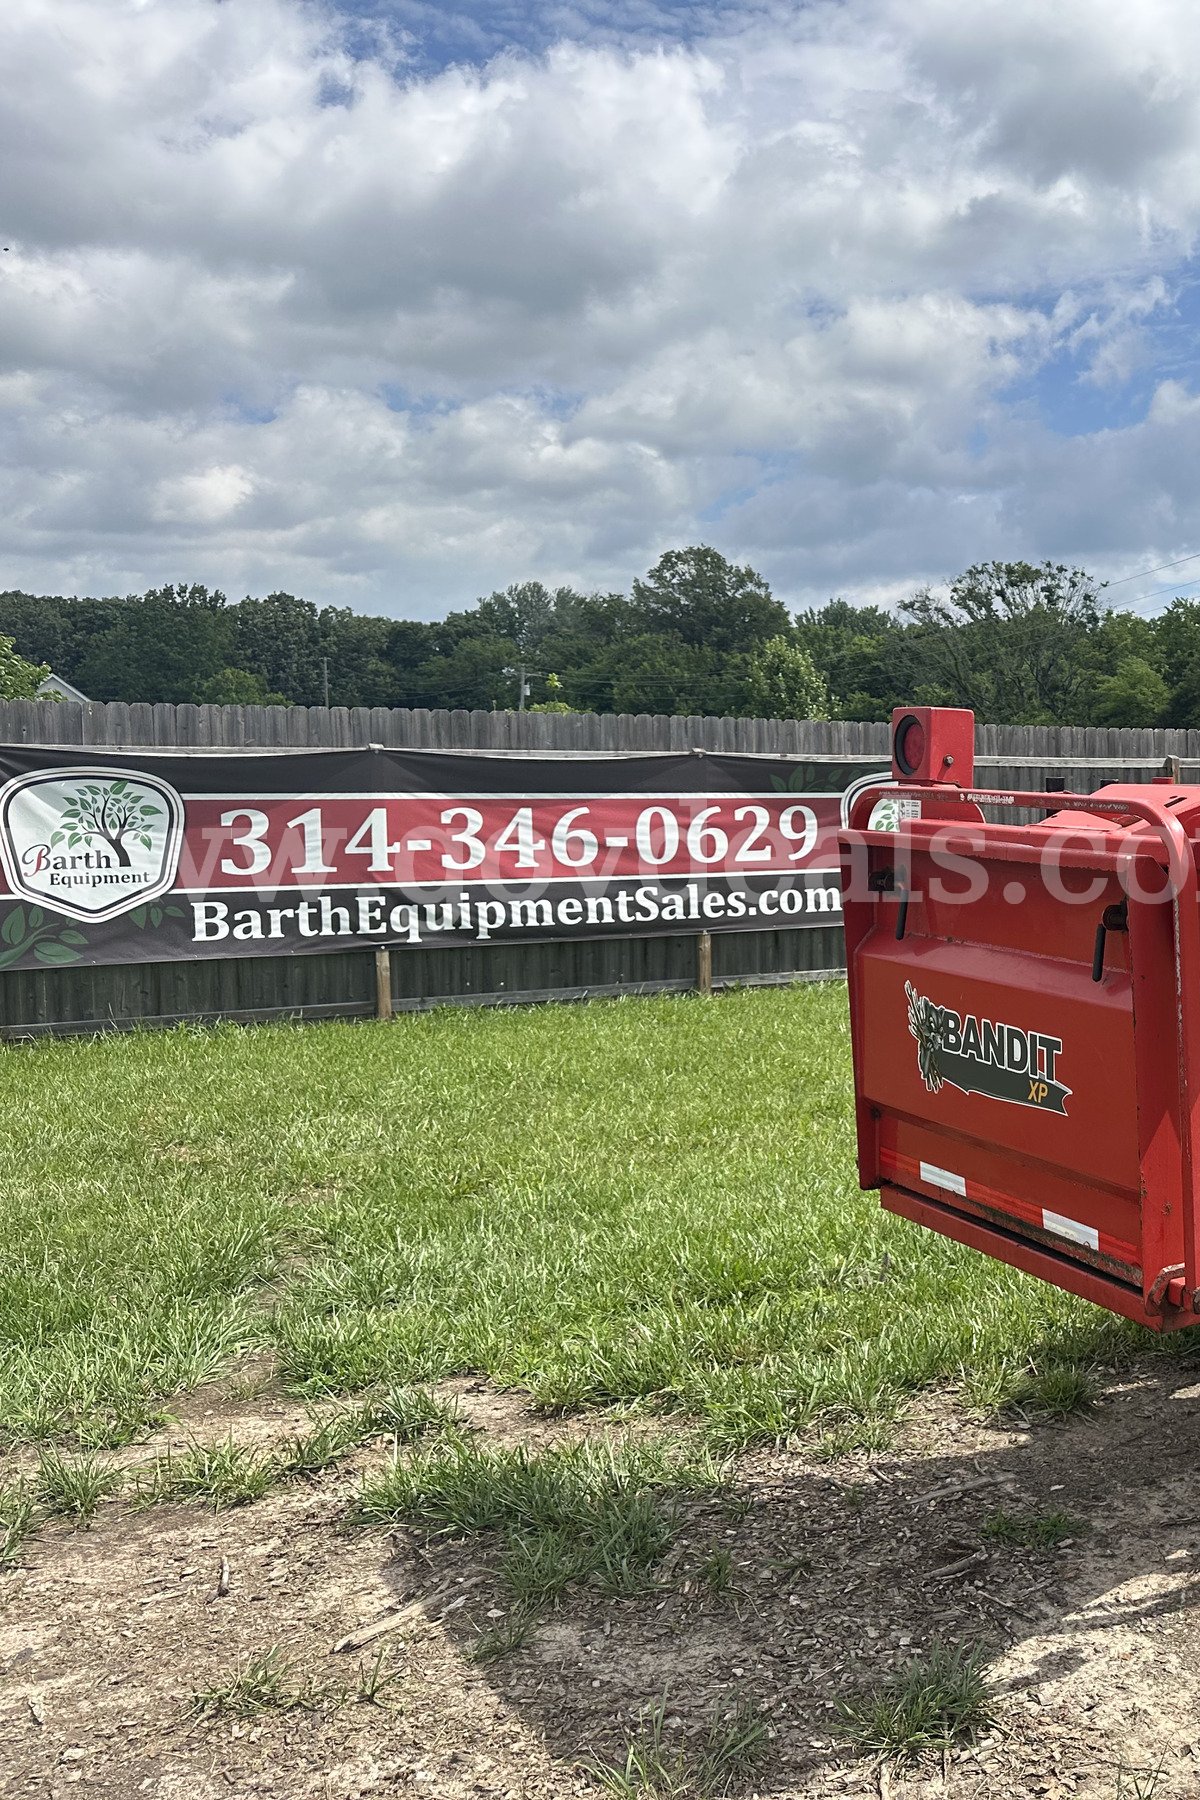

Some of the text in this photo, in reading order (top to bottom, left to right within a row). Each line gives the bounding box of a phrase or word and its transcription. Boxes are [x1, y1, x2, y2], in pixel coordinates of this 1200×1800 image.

[22, 843, 112, 878] Barth
[221, 804, 819, 876] 314-346-0629
[50, 871, 150, 889] Equipment
[190, 884, 843, 944] BarthEquipmentSales.com
[942, 1008, 1063, 1083] BANDIT
[1027, 1080, 1049, 1103] XP
